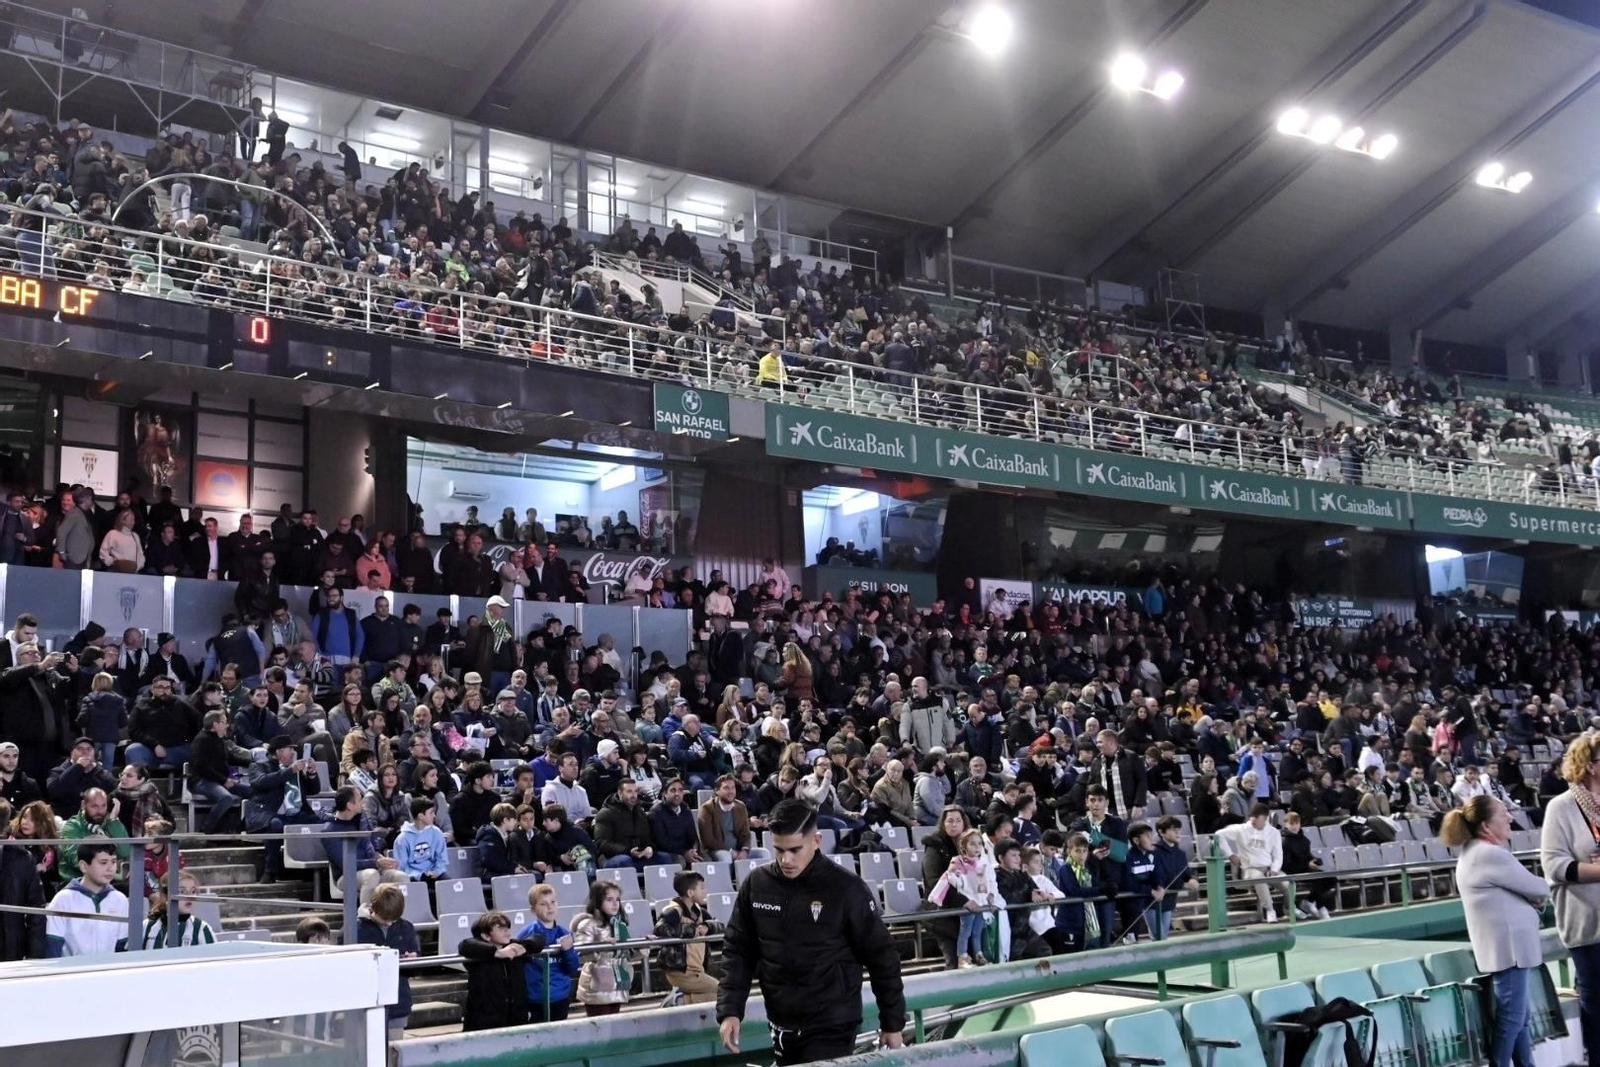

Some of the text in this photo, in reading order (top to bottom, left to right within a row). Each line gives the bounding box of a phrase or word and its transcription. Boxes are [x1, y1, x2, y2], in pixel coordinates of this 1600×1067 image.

[1, 274, 99, 315] BA CF
[656, 410, 726, 432] SAN RAFAEL
[816, 425, 906, 459] CaixaBank
[971, 447, 1050, 477] CaixaBank
[1107, 466, 1178, 493] CaixaBank
[1228, 482, 1291, 507] CaixaBank
[1336, 495, 1394, 517] CaixaBank
[583, 552, 671, 586] Coca-Cla
[860, 581, 909, 593] SILON
[1042, 586, 1127, 606] AMOPSUR
[1316, 616, 1347, 628] RAFL
[1347, 618, 1373, 628] MOT
[752, 902, 782, 912] GIVOVA
